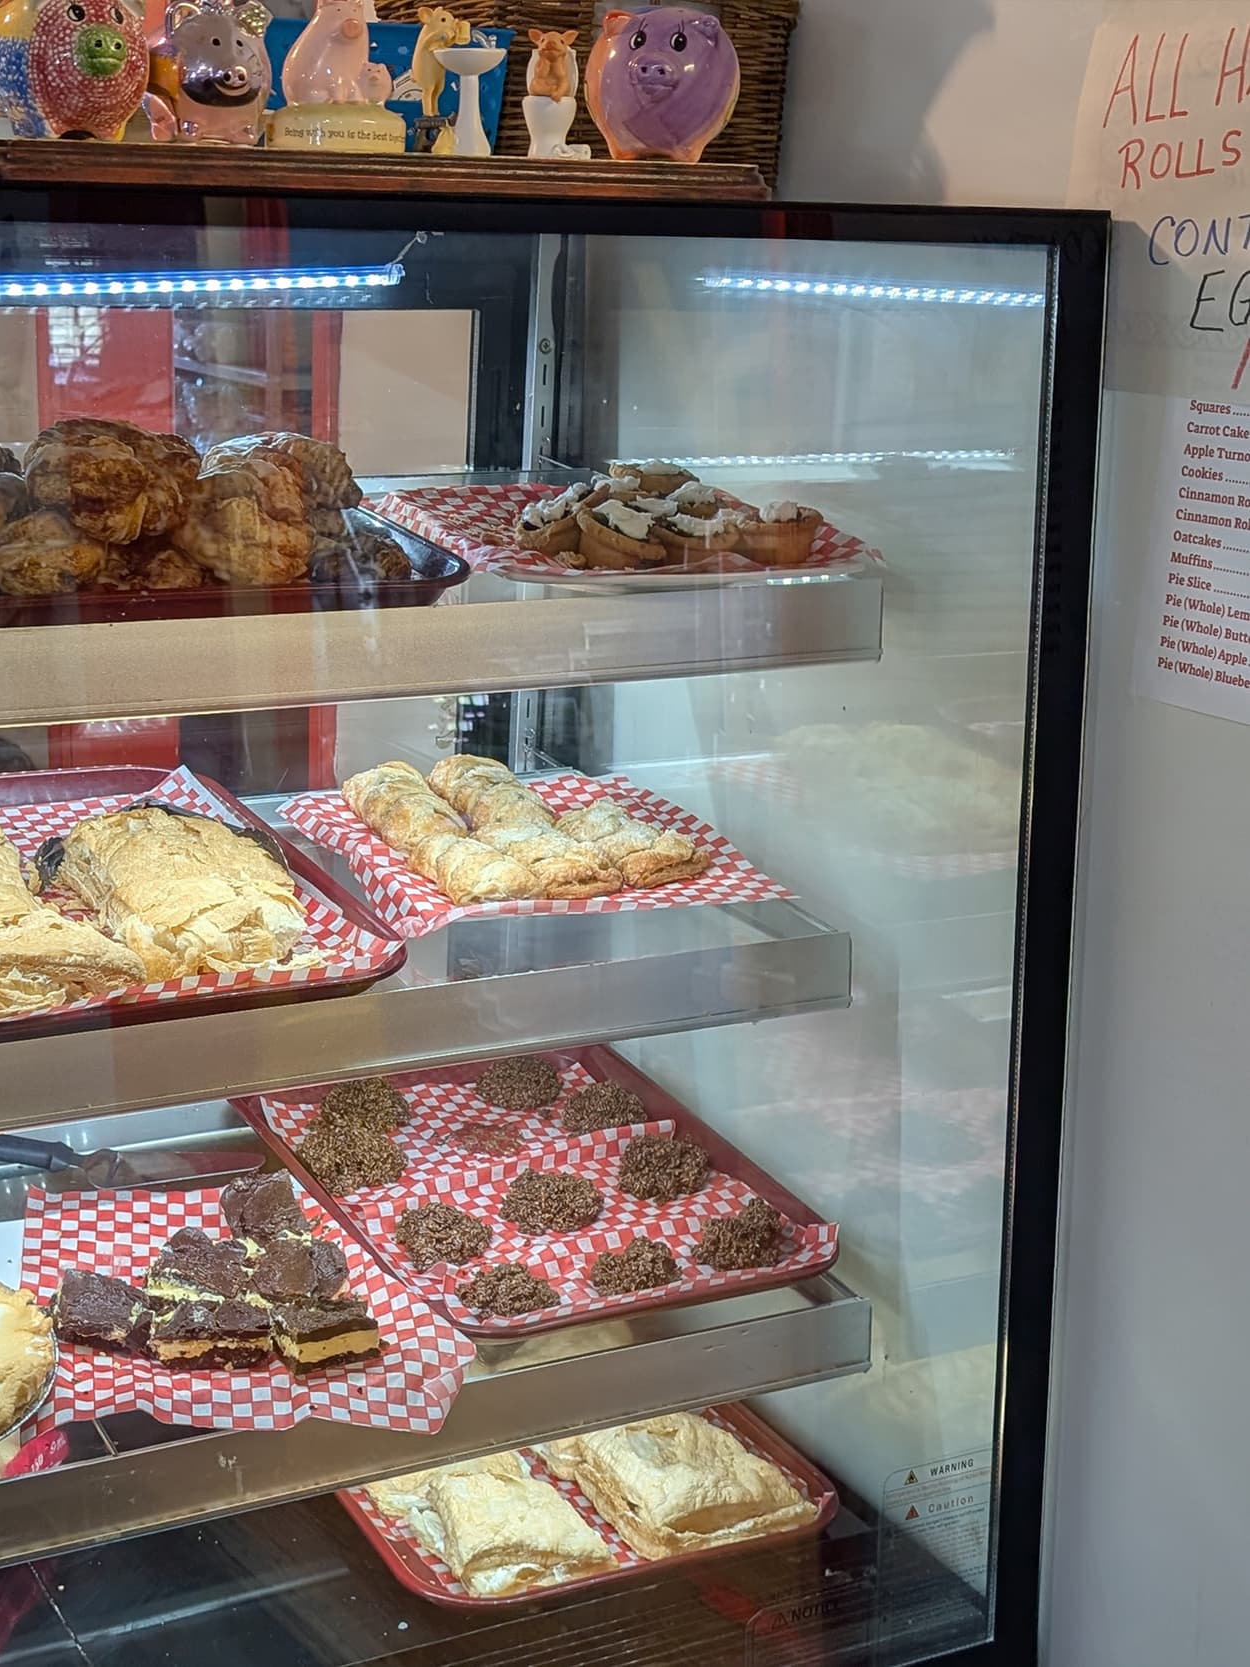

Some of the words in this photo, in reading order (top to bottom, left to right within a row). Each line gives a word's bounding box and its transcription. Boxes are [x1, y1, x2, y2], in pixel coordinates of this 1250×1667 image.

[1103, 32, 1188, 128] ALL
[1214, 26, 1250, 106] H
[284, 127, 304, 138] Being
[327, 129, 345, 139] you
[347, 129, 356, 139] is
[357, 129, 371, 140] the
[1118, 129, 1242, 190] ROLLS
[1189, 399, 1232, 415] Squares
[1187, 421, 1221, 436] Carrot
[1222, 425, 1250, 439] Cake
[1183, 443, 1215, 460] Apple
[1217, 447, 1250, 462] Turno
[1181, 465, 1224, 482] Cookies
[1178, 486, 1235, 506] Cinnamon
[1176, 508, 1232, 528] Cinnamon
[1173, 530, 1223, 548] Oatcakes
[1170, 551, 1213, 570] Muffins
[1168, 572, 1185, 586] Pie
[1186, 575, 1212, 591] Slice
[1165, 593, 1182, 607] Pie
[1183, 596, 1225, 619] (Whole)
[1162, 614, 1179, 628] Pie
[1181, 618, 1223, 640] (Whole)
[1224, 627, 1250, 644] Butt
[1160, 635, 1176, 649] Pie
[1177, 639, 1217, 661] (Whole)
[1217, 648, 1248, 667] Apple
[1157, 656, 1173, 670] Pie
[1174, 659, 1214, 682] (Whole)
[930, 1458, 975, 1477] WARNING
[928, 1494, 975, 1514] Caution
